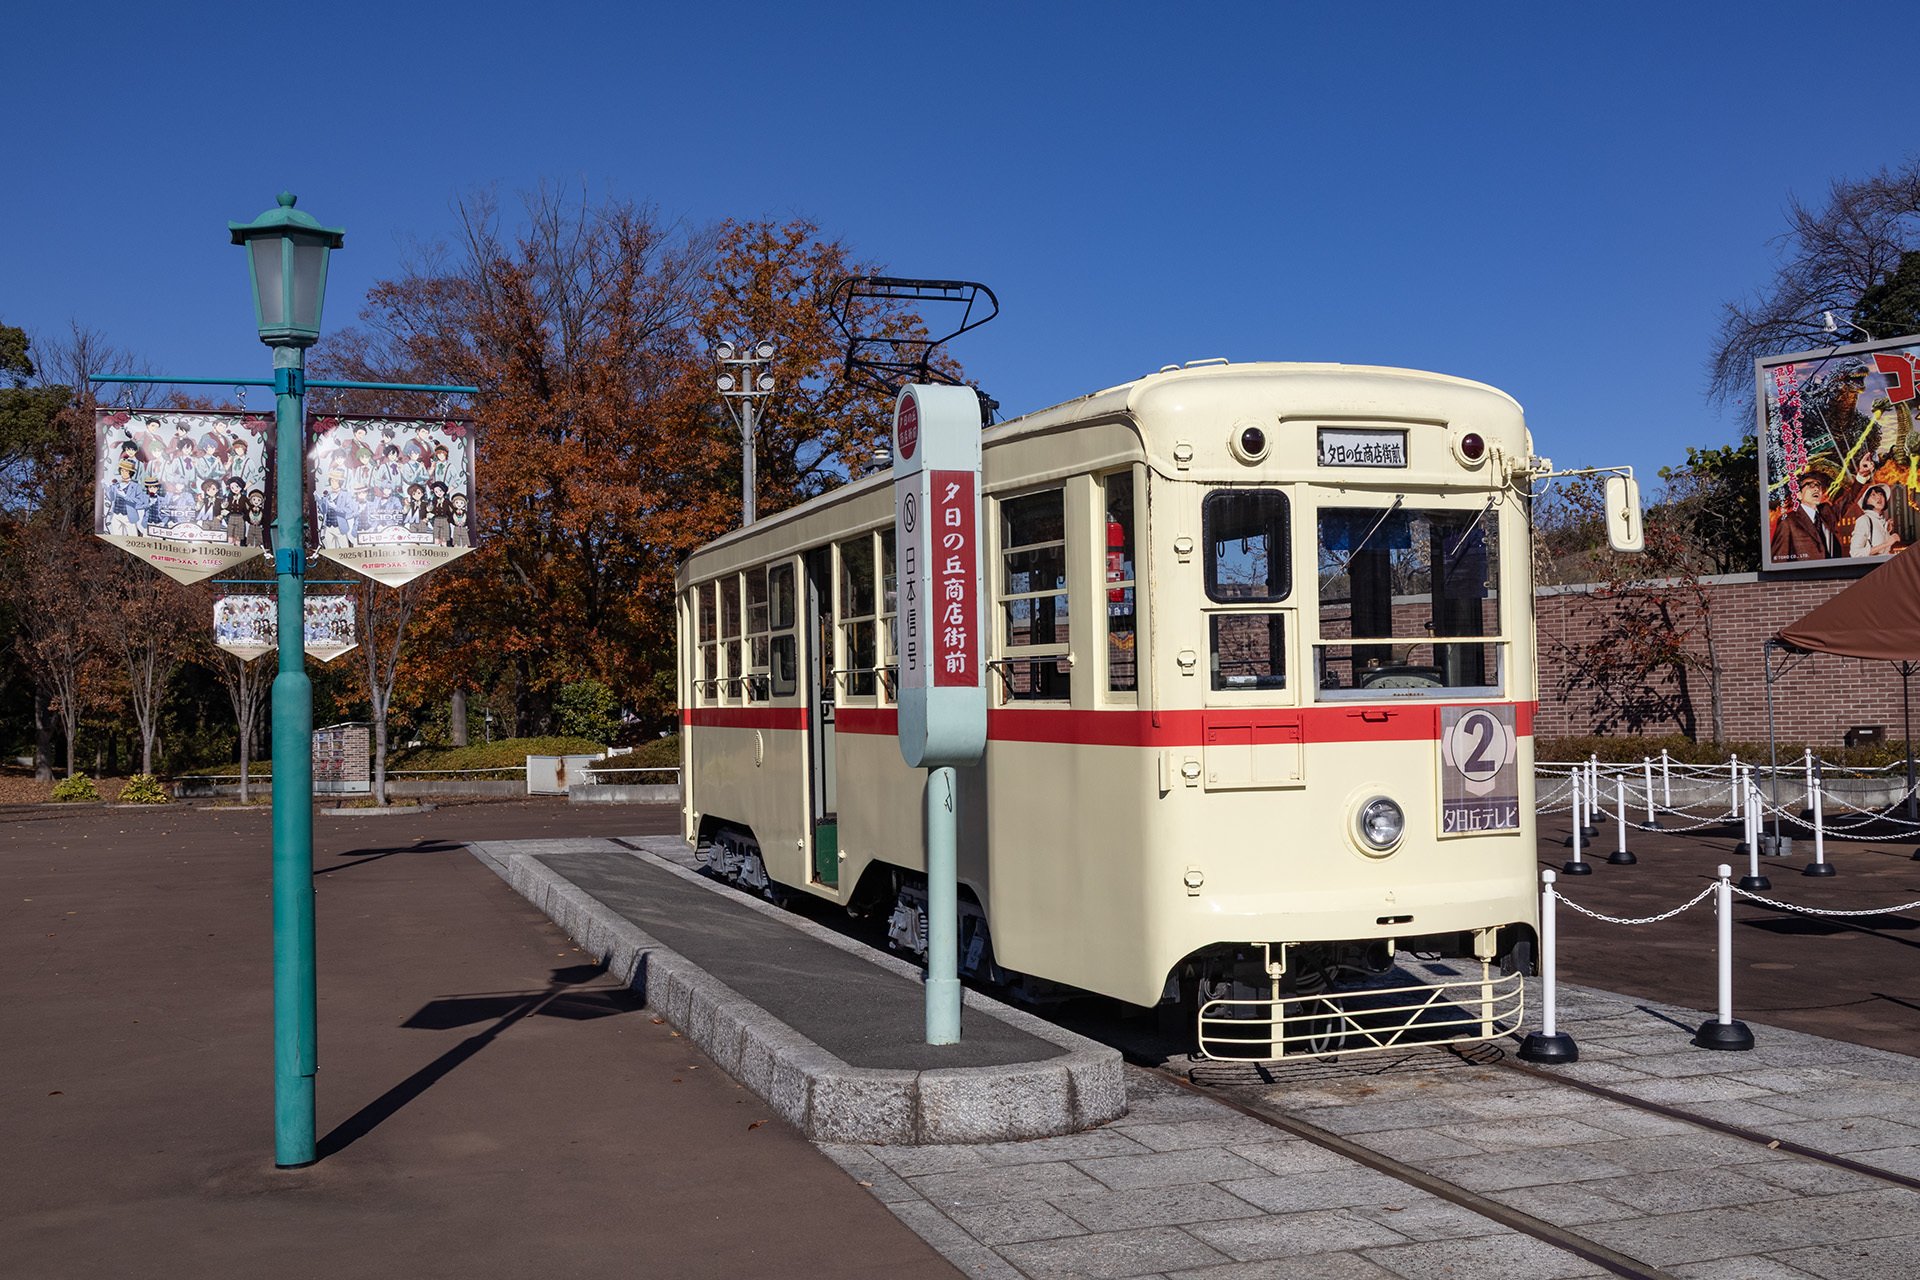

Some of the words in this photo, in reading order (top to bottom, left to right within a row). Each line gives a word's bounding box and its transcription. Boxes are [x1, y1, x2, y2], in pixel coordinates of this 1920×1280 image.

[1872, 352, 1920, 405] ゴ
[1327, 442, 1402, 464] 夕日の丘商店街前
[941, 481, 967, 674] 夕日の丘商店街前
[906, 546, 917, 671] 日本信号
[1463, 713, 1496, 773] 2
[1444, 806, 1518, 833] 夕日丘テレビ
